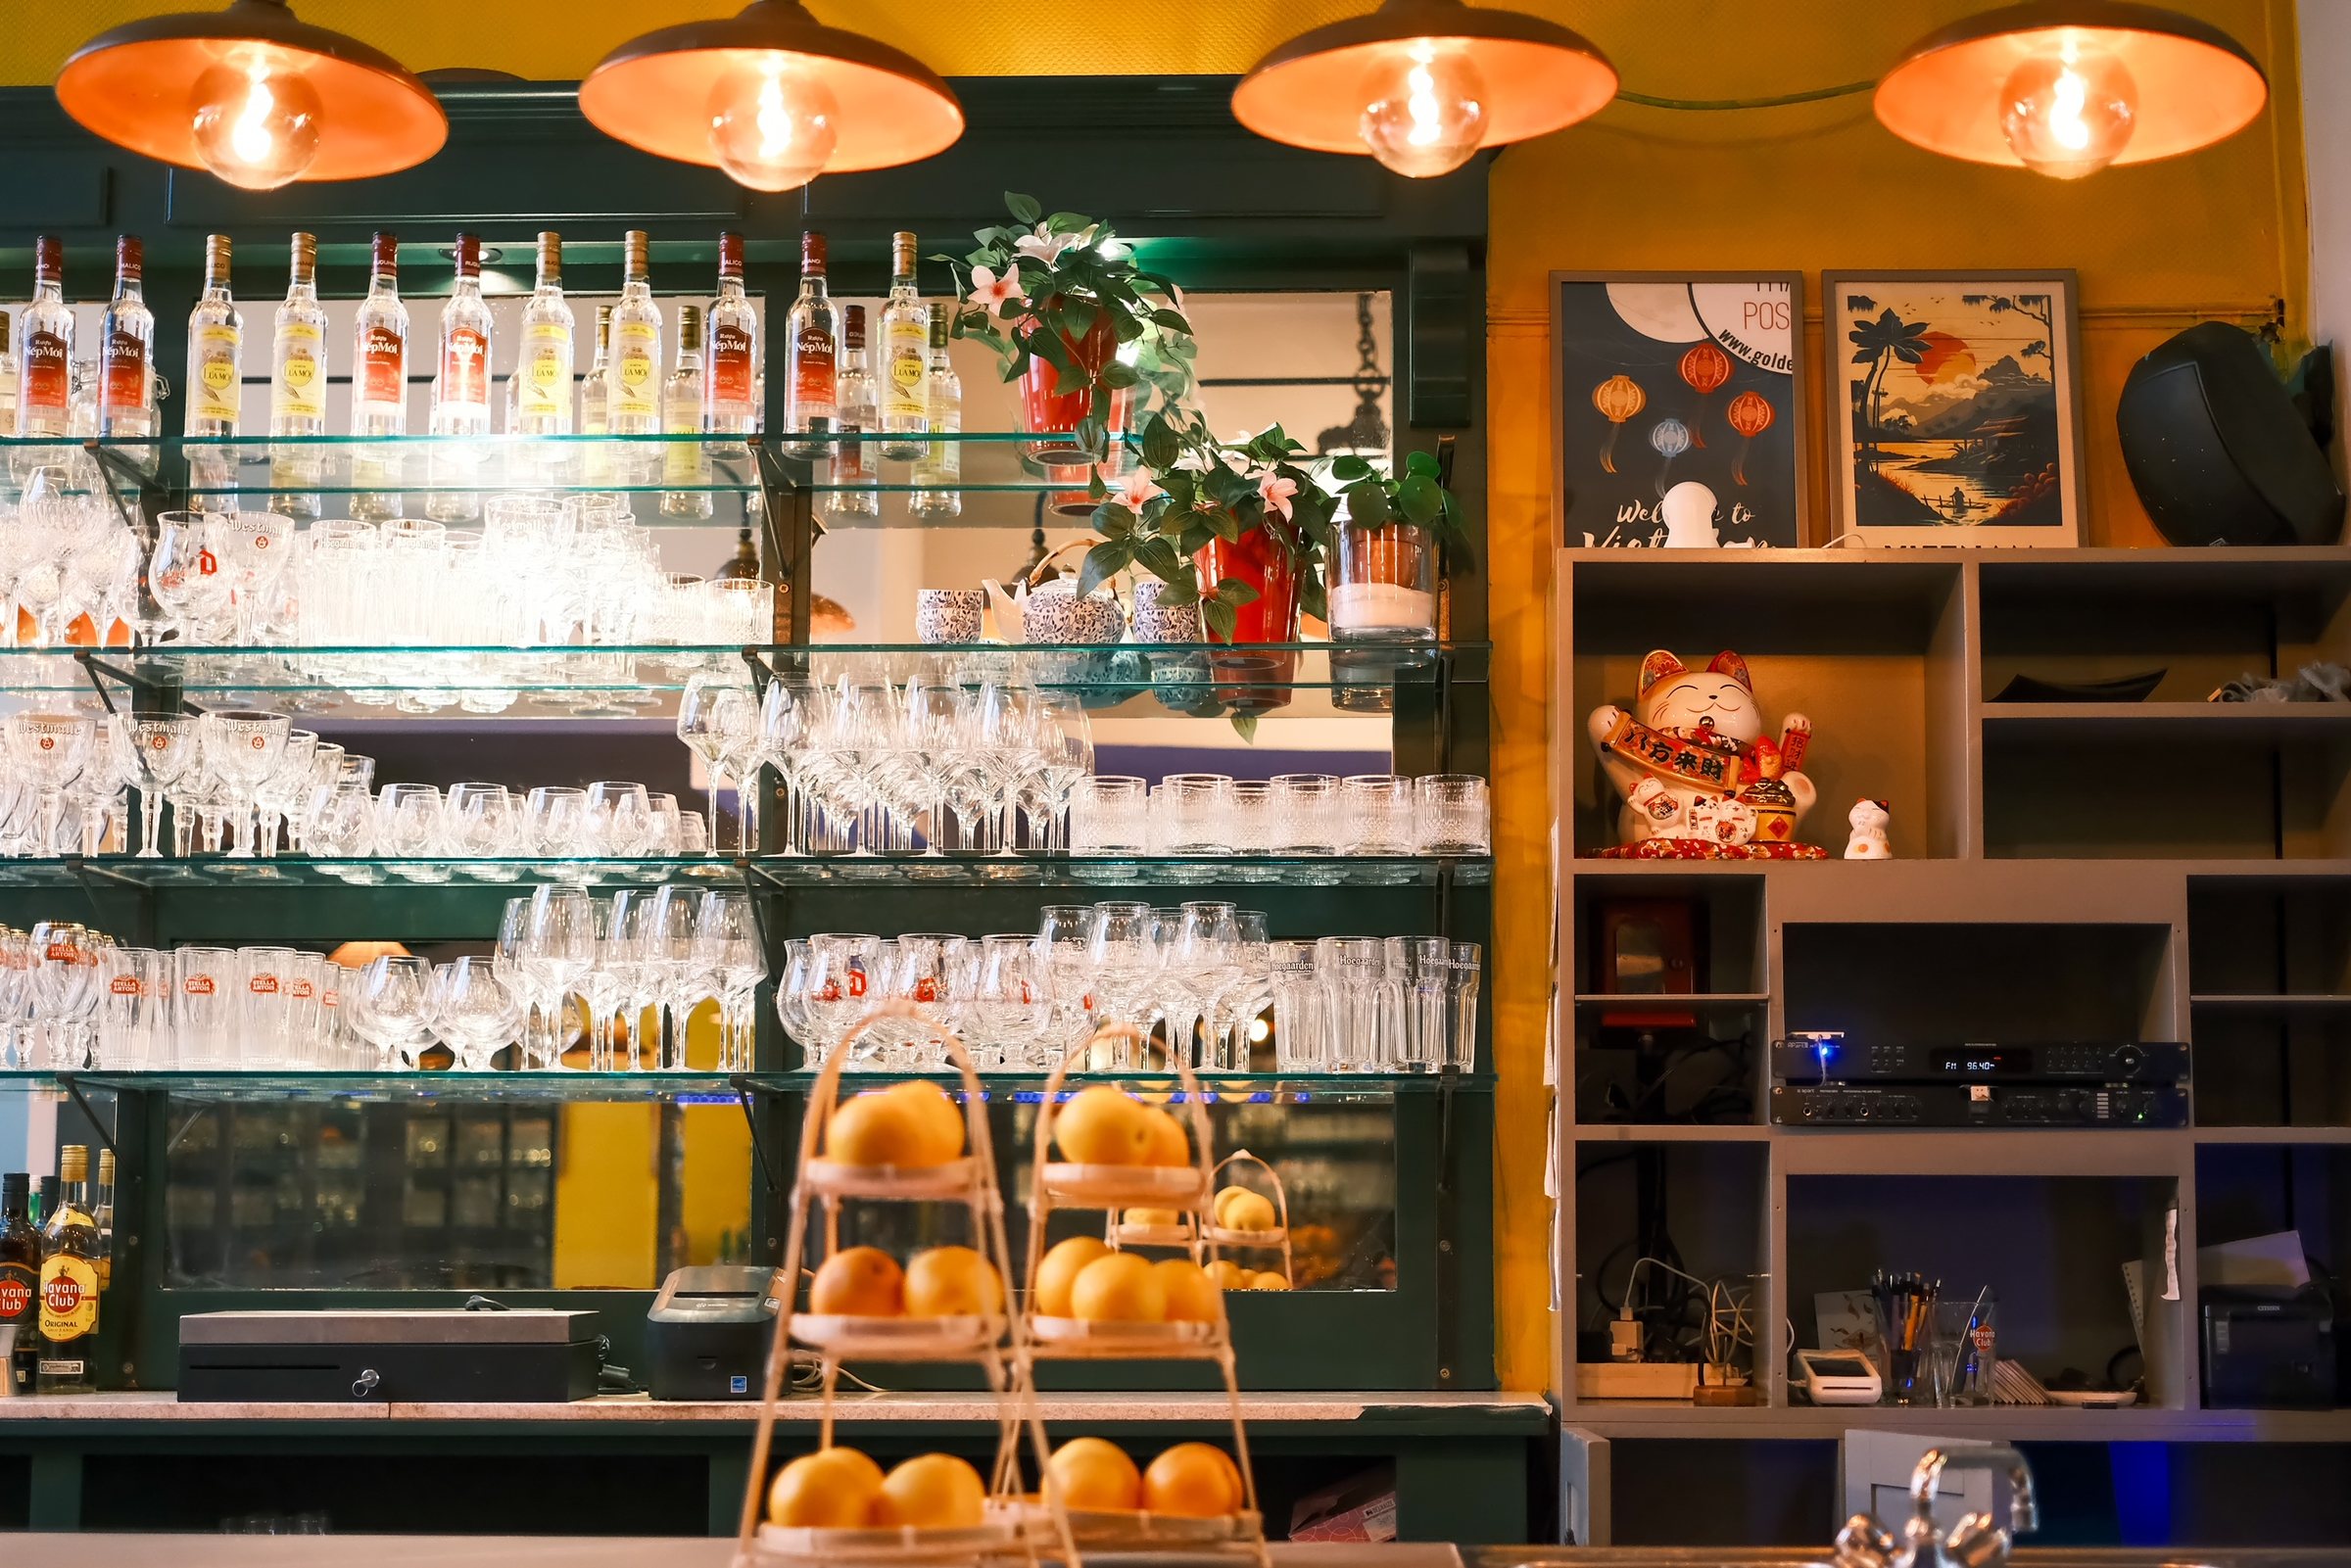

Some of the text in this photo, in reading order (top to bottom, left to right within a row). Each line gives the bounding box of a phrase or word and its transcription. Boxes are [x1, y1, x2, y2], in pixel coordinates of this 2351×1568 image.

[1731, 502, 1756, 524] to
[44, 1283, 85, 1294] Havana
[0, 1298, 22, 1310] lub
[48, 1294, 74, 1307] Club
[1976, 1338, 1990, 1346] Club
